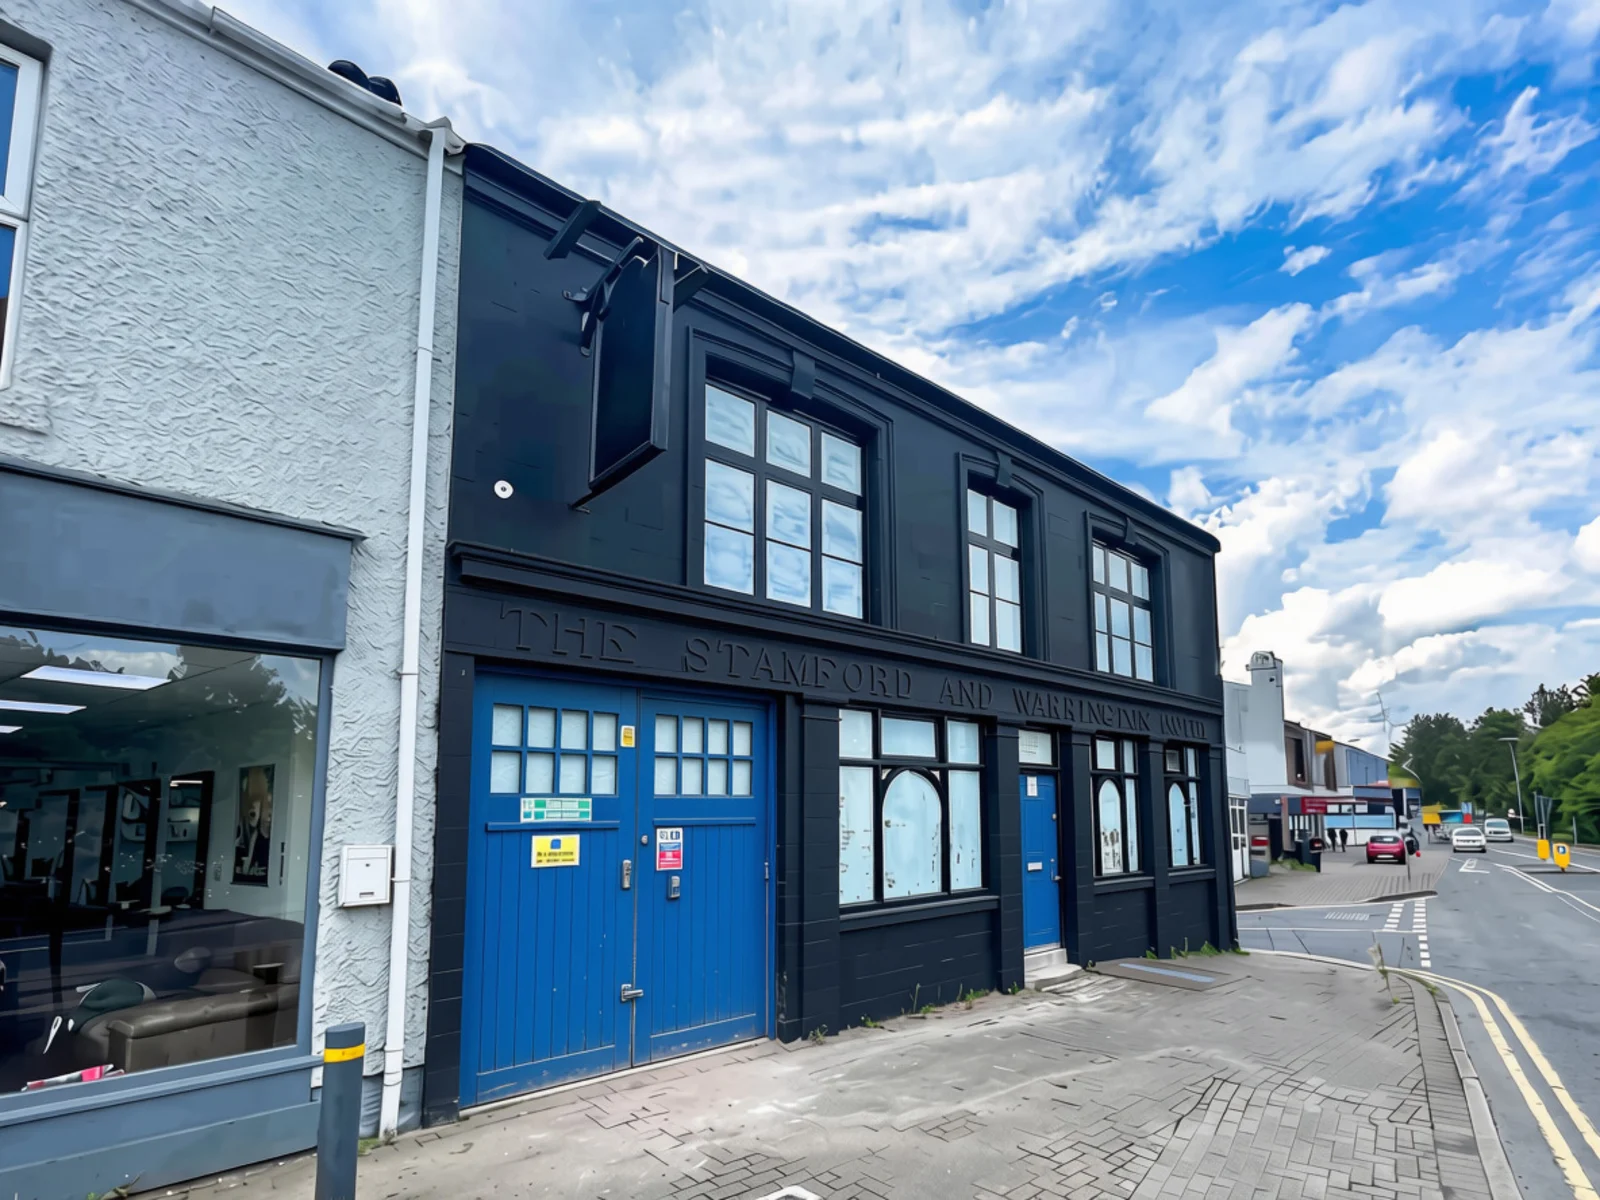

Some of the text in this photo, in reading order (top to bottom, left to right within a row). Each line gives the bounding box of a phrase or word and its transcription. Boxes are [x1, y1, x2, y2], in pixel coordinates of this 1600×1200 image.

[500, 604, 637, 664] THE
[682, 638, 912, 699] STAMFORD
[938, 676, 993, 710] AND
